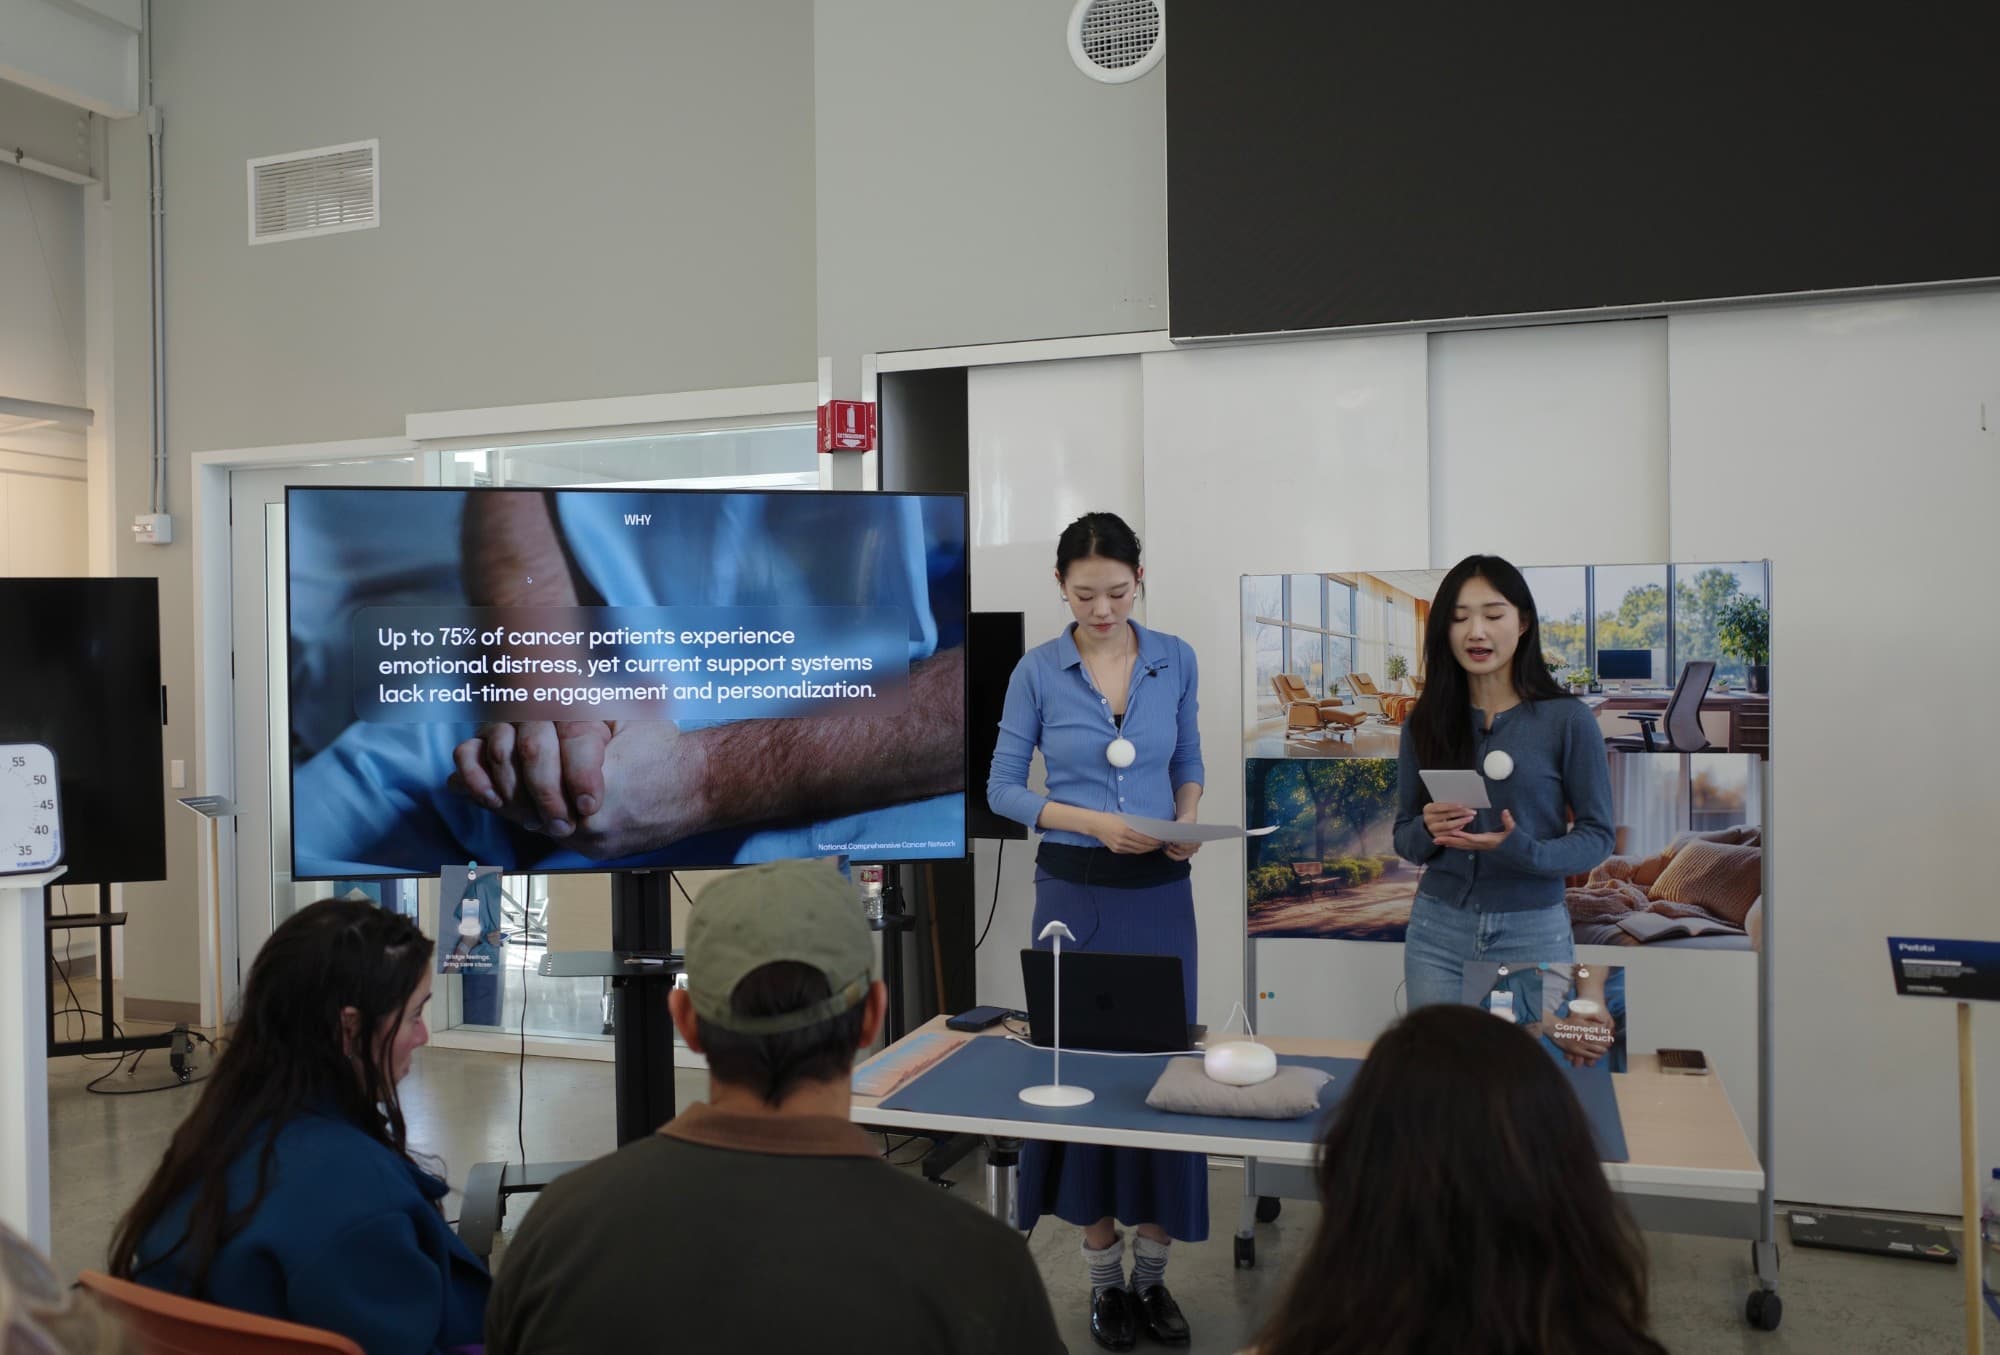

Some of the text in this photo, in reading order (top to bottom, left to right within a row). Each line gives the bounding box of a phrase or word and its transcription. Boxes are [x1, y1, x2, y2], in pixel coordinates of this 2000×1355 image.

[624, 514, 652, 526] WHY
[378, 626, 795, 651] Up to 75% of cancer patients experience
[378, 655, 873, 677] emotional distress, yet current support systems
[379, 680, 877, 705] lack real-time engagement and personalization.
[12, 756, 26, 768] 55
[33, 774, 47, 785] 50
[40, 799, 54, 810] 45
[34, 824, 49, 835] 40
[18, 845, 33, 856] 35
[818, 839, 956, 851] National Comprehensive Cancer Network
[1555, 1023, 1611, 1034] Connect in
[1553, 1032, 1615, 1043] every touch
